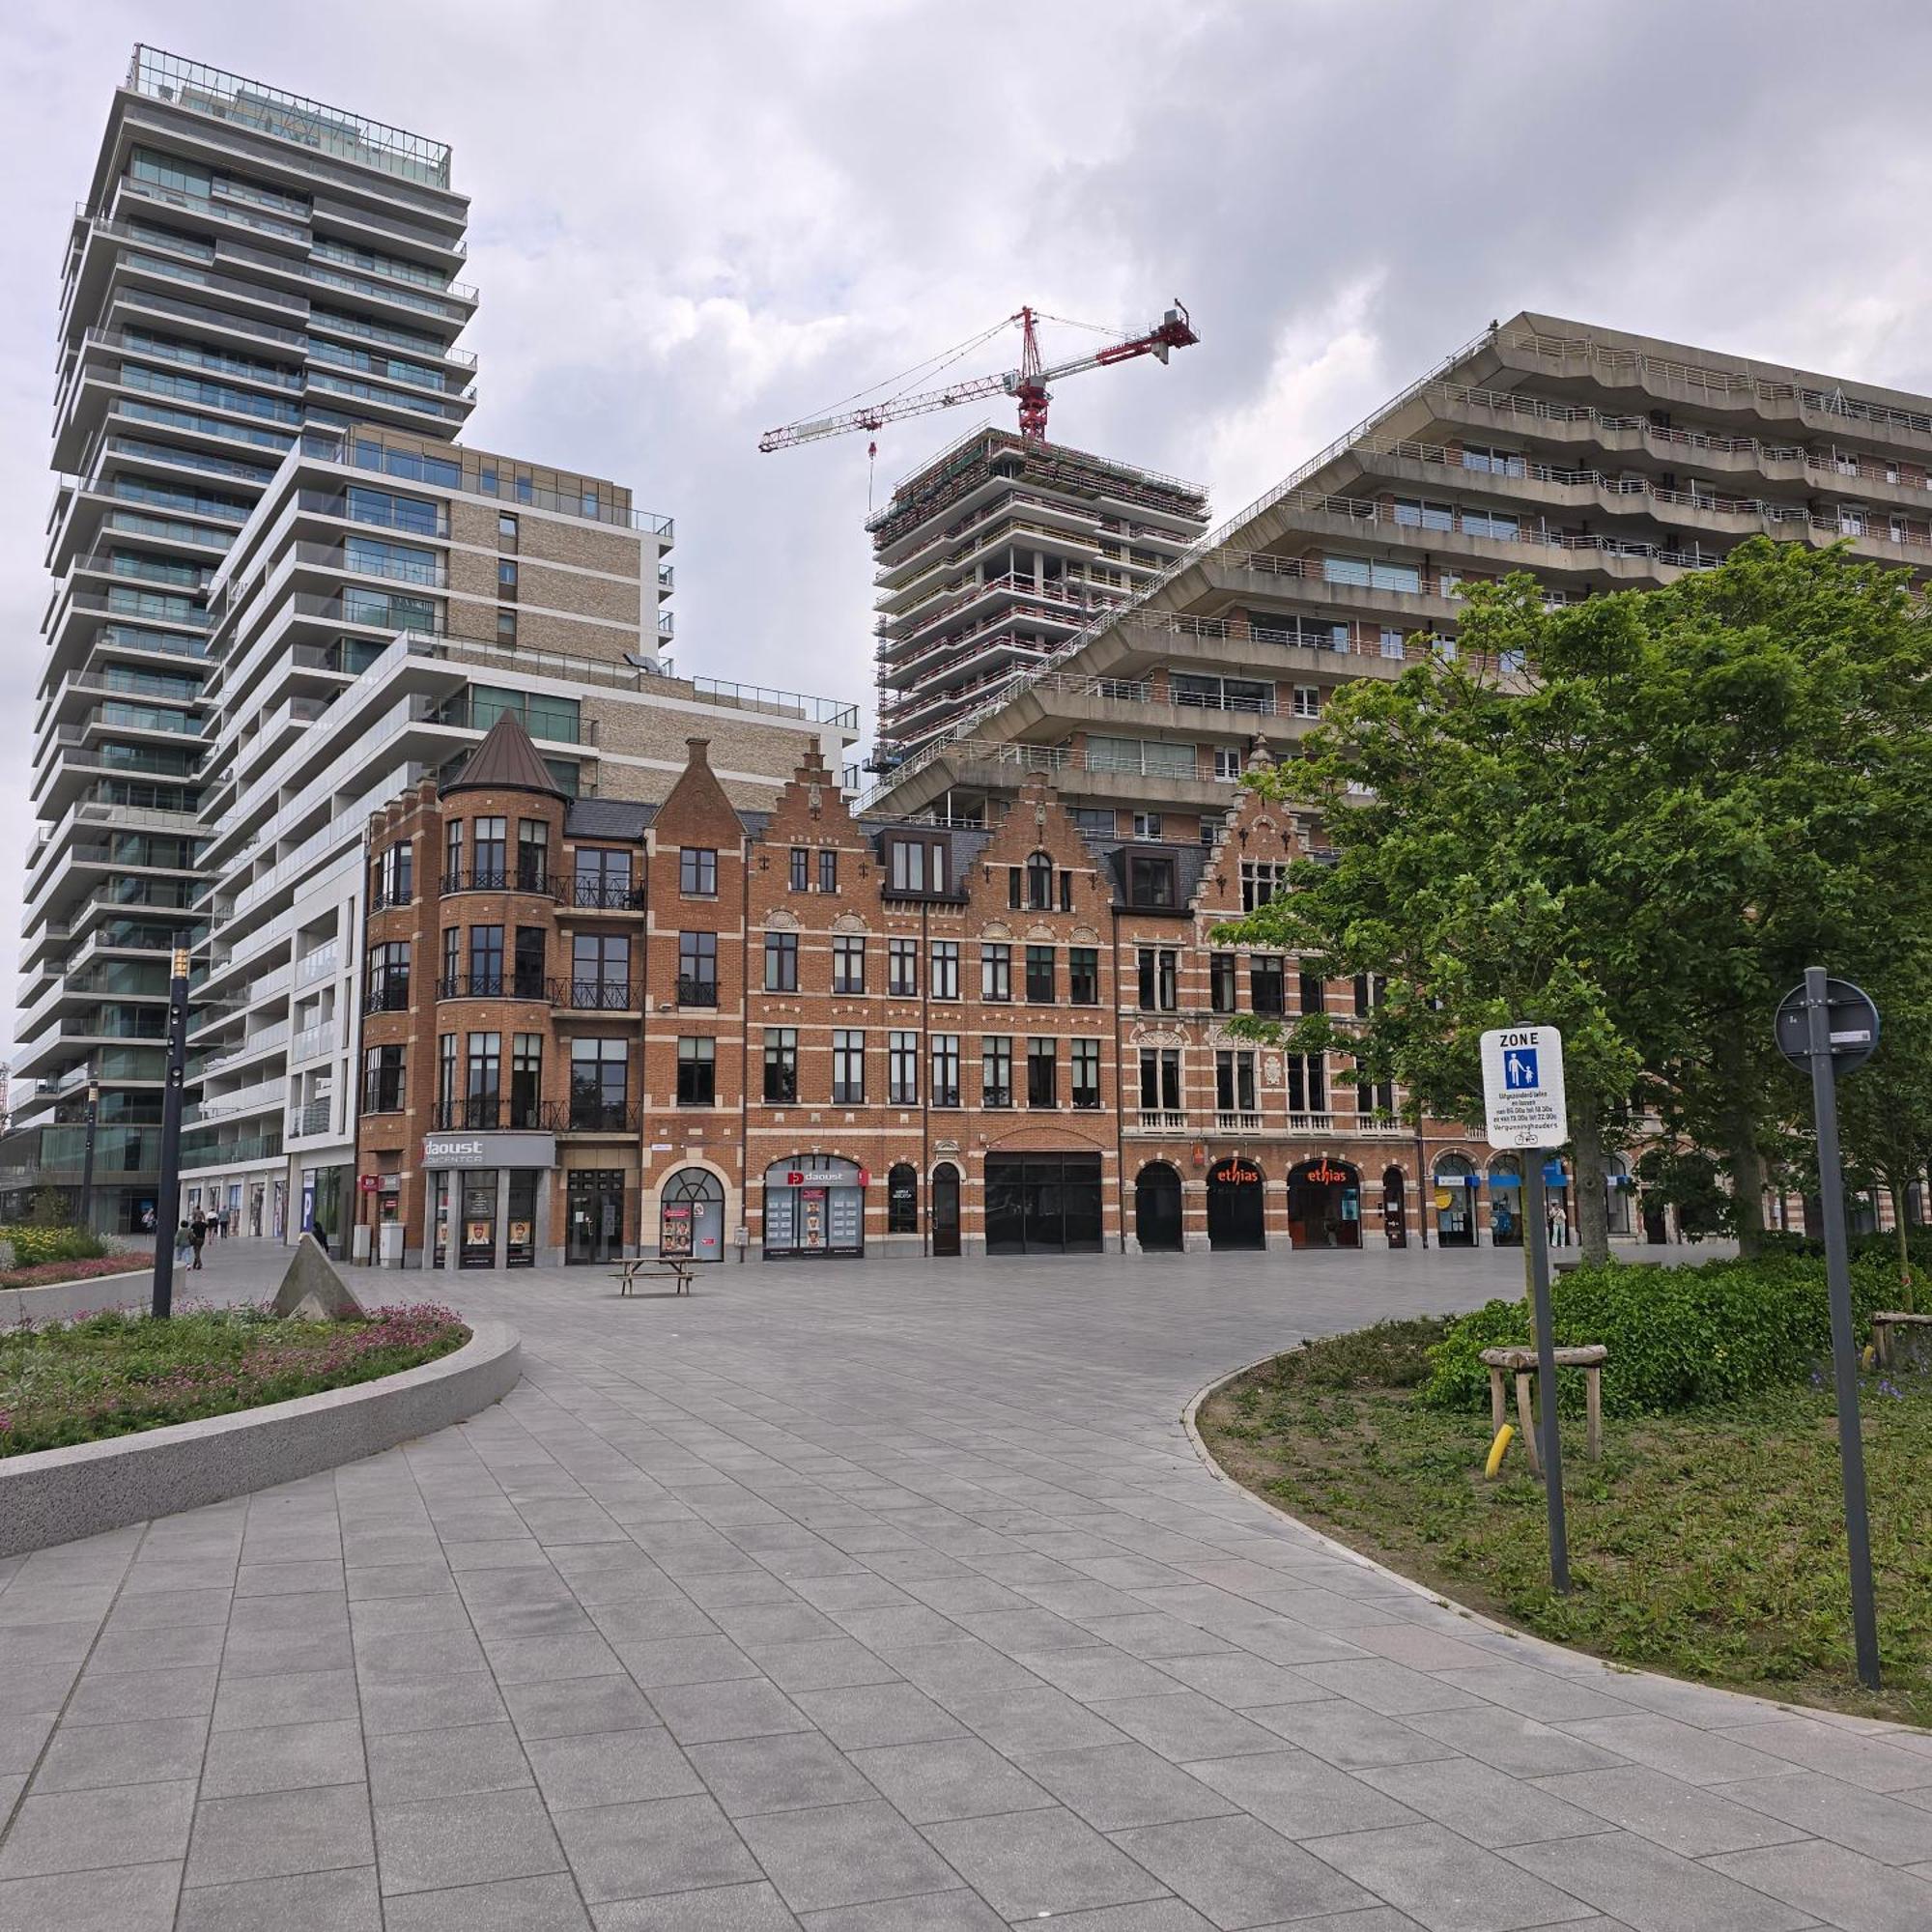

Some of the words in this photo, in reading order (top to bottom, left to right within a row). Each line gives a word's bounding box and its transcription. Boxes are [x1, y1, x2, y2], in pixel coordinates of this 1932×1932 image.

[1499, 1033, 1539, 1047] ZONE
[425, 1140, 483, 1155] daoust
[1217, 1158, 1258, 1185] ethias
[1308, 1158, 1347, 1185] ethias
